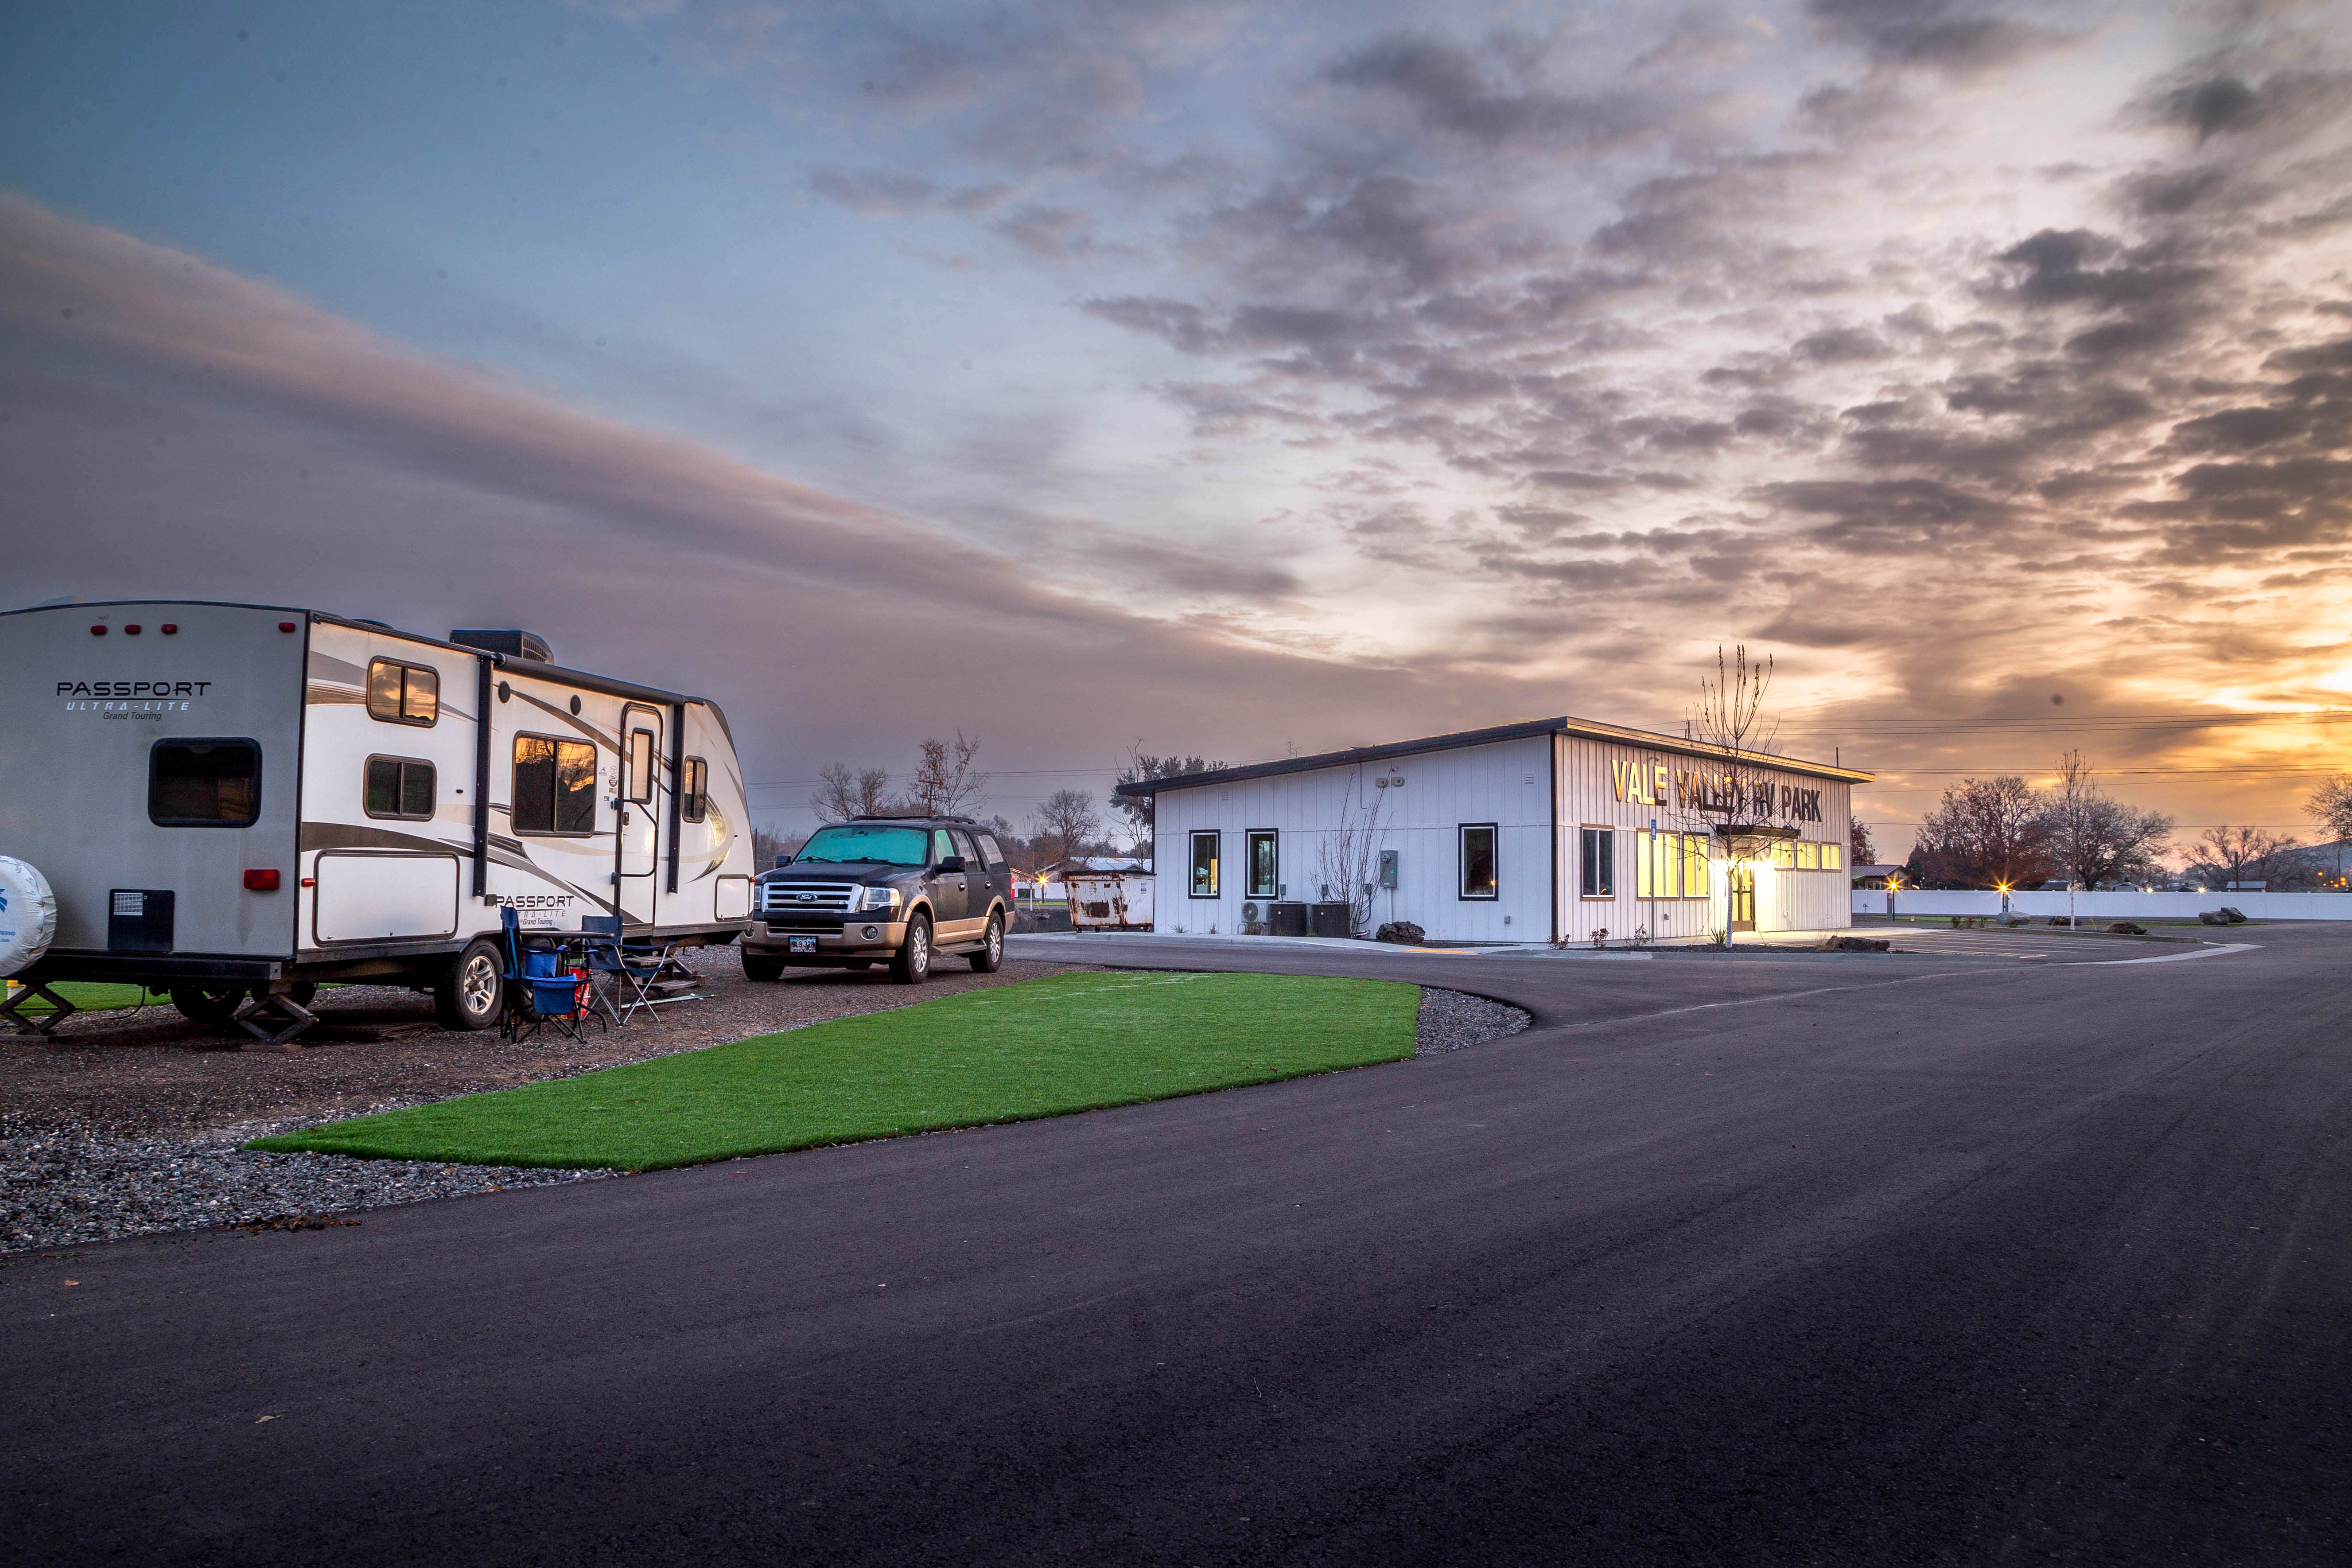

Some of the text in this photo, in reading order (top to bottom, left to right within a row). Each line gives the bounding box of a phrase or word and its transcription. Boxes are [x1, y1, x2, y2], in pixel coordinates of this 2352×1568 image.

[57, 681, 212, 696] PASSPORT
[66, 702, 190, 711] ULTRA-LITE
[103, 712, 162, 722] Grand Touring
[1612, 759, 1822, 823] VALE VALLEY RV PARK
[495, 895, 575, 908] PASSPORT
[537, 918, 553, 926] Touring
